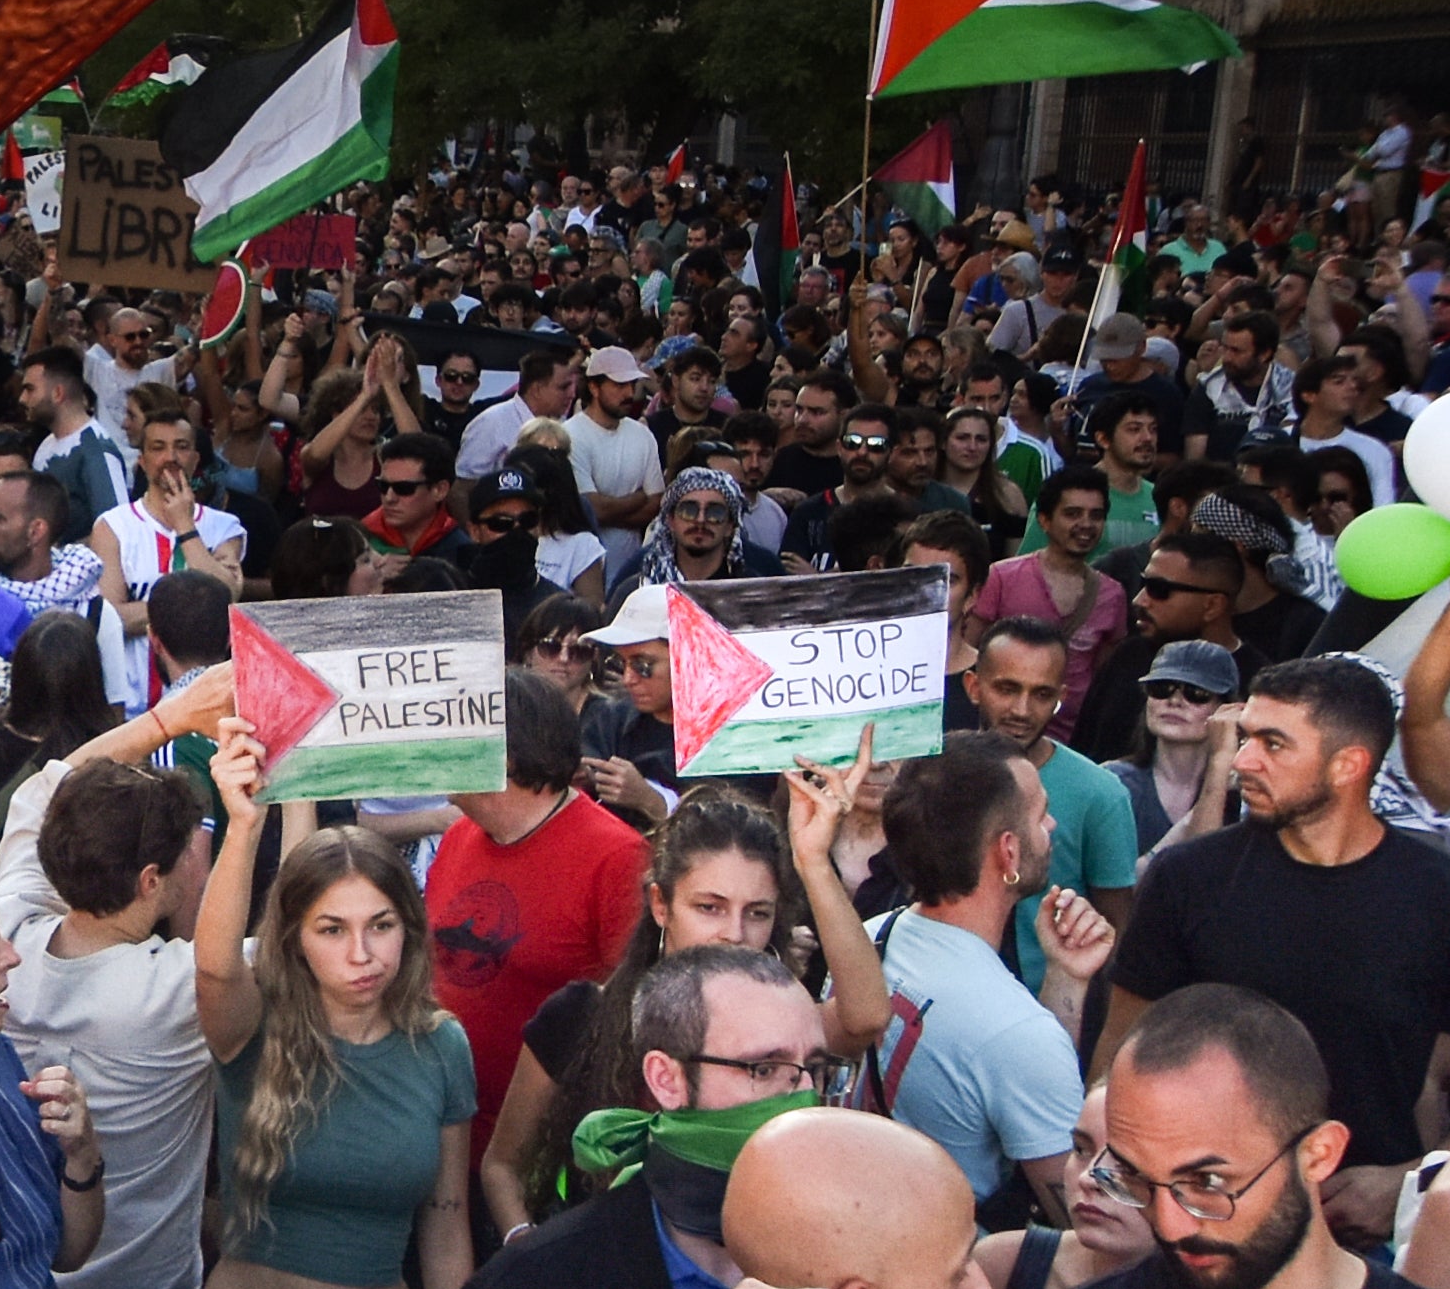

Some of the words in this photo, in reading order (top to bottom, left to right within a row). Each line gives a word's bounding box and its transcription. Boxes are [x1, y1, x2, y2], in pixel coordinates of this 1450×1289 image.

[78, 143, 183, 191] PALES
[789, 623, 905, 666] STOP
[357, 649, 458, 690] FREE
